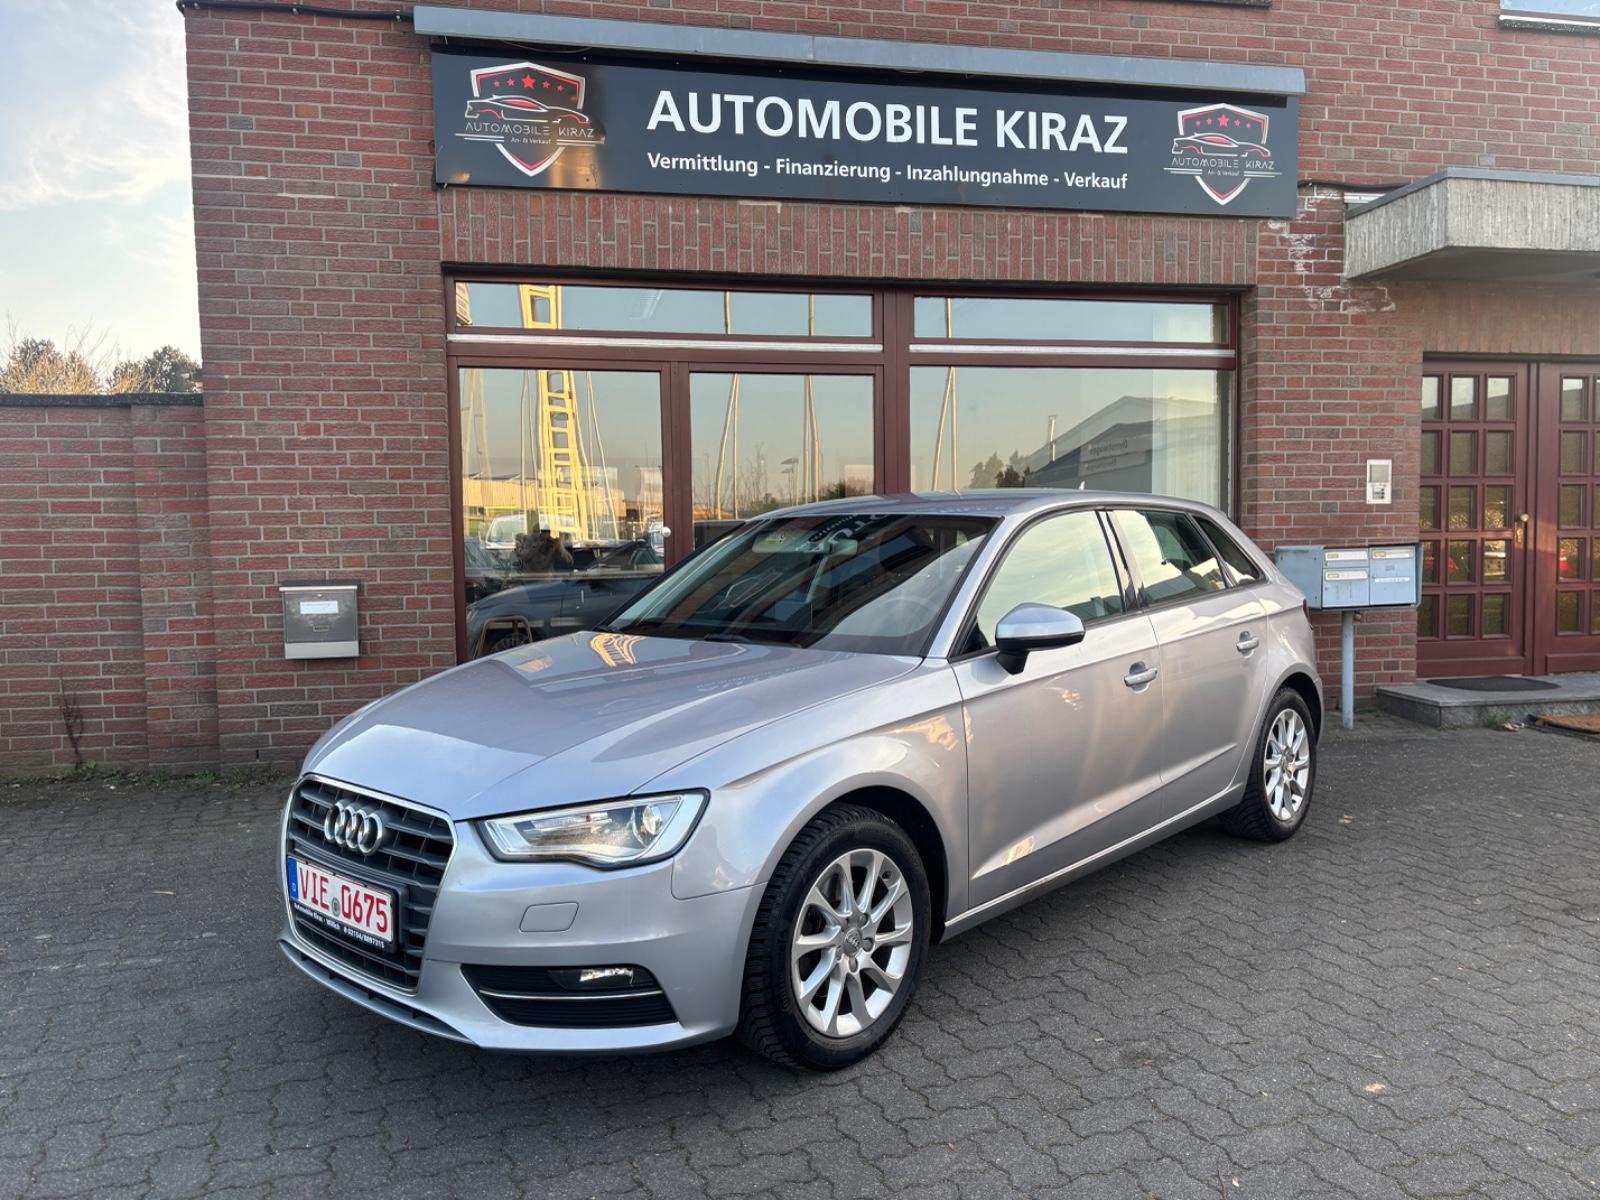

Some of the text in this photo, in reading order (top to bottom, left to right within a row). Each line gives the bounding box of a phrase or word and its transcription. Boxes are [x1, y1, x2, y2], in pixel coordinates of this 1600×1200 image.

[465, 121, 595, 138] AUTOMOBILE KIRAZ
[646, 89, 1128, 154] AUTOMOBILE KIRAZ
[647, 151, 758, 177] Vermittlung
[776, 157, 891, 183] Finanzierung
[907, 164, 1049, 187] Inzahlungnahme
[1064, 171, 1128, 190] Verkauf
[1171, 157, 1275, 170] AUTOMOBILE KIRAZ
[299, 866, 330, 911] VIE
[340, 884, 388, 933] 0675
